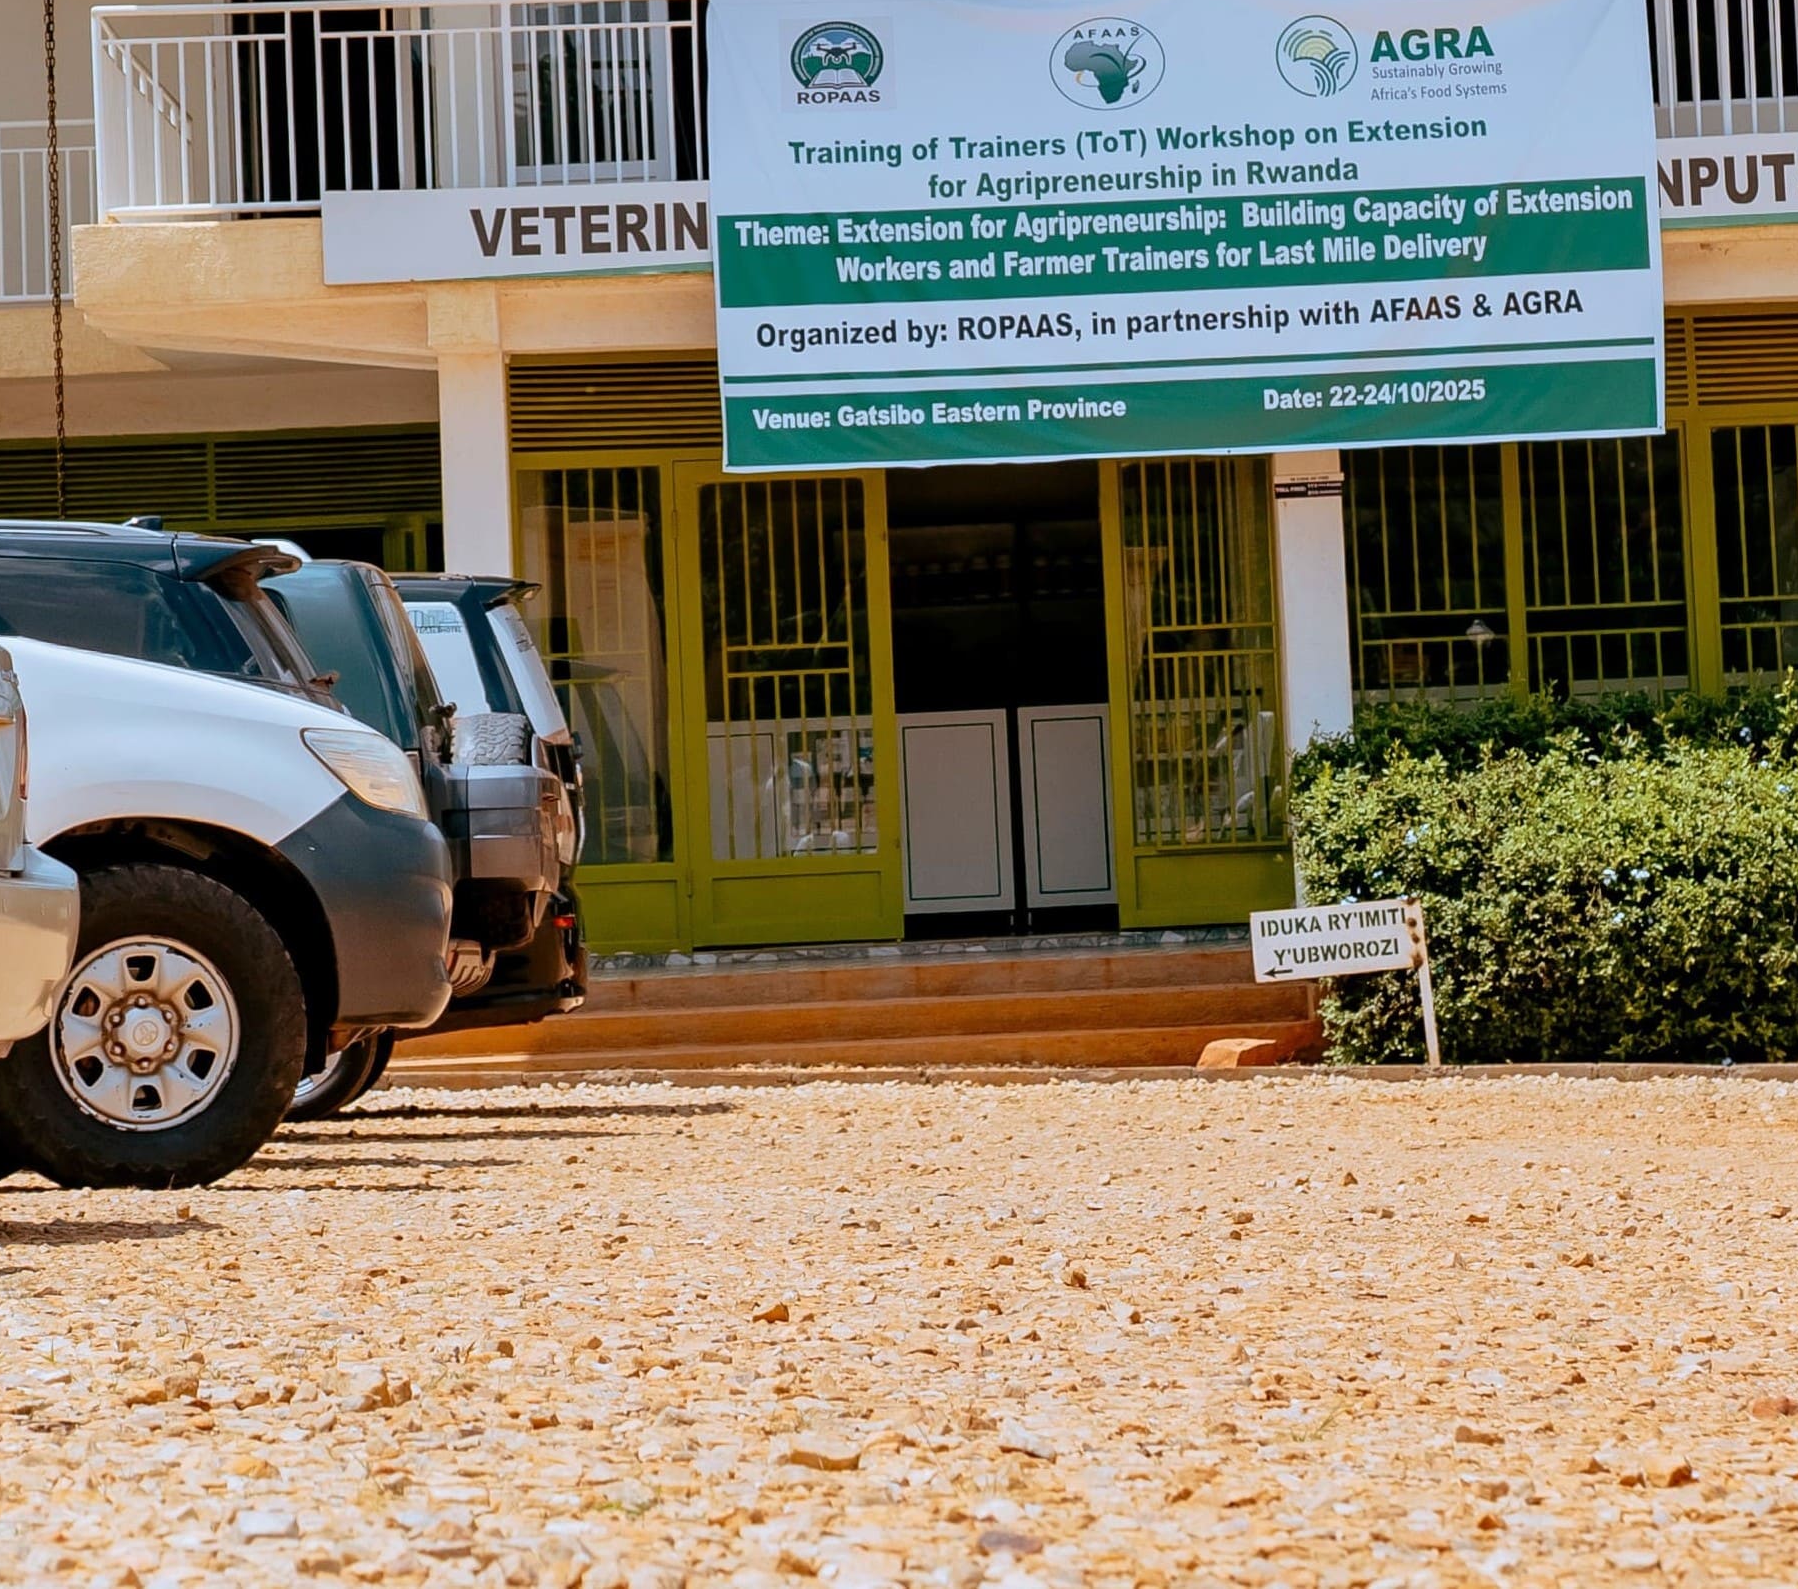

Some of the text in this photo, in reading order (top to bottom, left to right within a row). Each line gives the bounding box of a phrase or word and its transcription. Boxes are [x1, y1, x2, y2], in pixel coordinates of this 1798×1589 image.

[1073, 26, 1140, 40] AFAAS
[1370, 25, 1495, 62] AGRA
[1372, 60, 1503, 80] Sustainably Growing
[797, 90, 881, 104] ROPAAS
[1371, 83, 1507, 101] Africa's Food Systems
[788, 116, 1487, 167] Training of Trainers (ToT) Workshop on Extension
[928, 158, 1359, 202] for Agripreneurship in Rwanda
[734, 185, 1633, 247] Theme: Extension for Agripreneurship: Building Capacity of Extension
[836, 233, 1487, 283] Workers and Farmer Trainers for Last Mile Delivery
[756, 289, 1584, 352] Organized by: ROPAAS, in partnership with AFAAS & AGRA
[1263, 379, 1486, 410] Date: 22-24/10/2025
[752, 397, 1127, 430] Venue: Gatsibo Eastern Province
[1260, 907, 1406, 938] IDUKA RY'IMITI
[1274, 939, 1399, 966] Y'UBWOROZI
